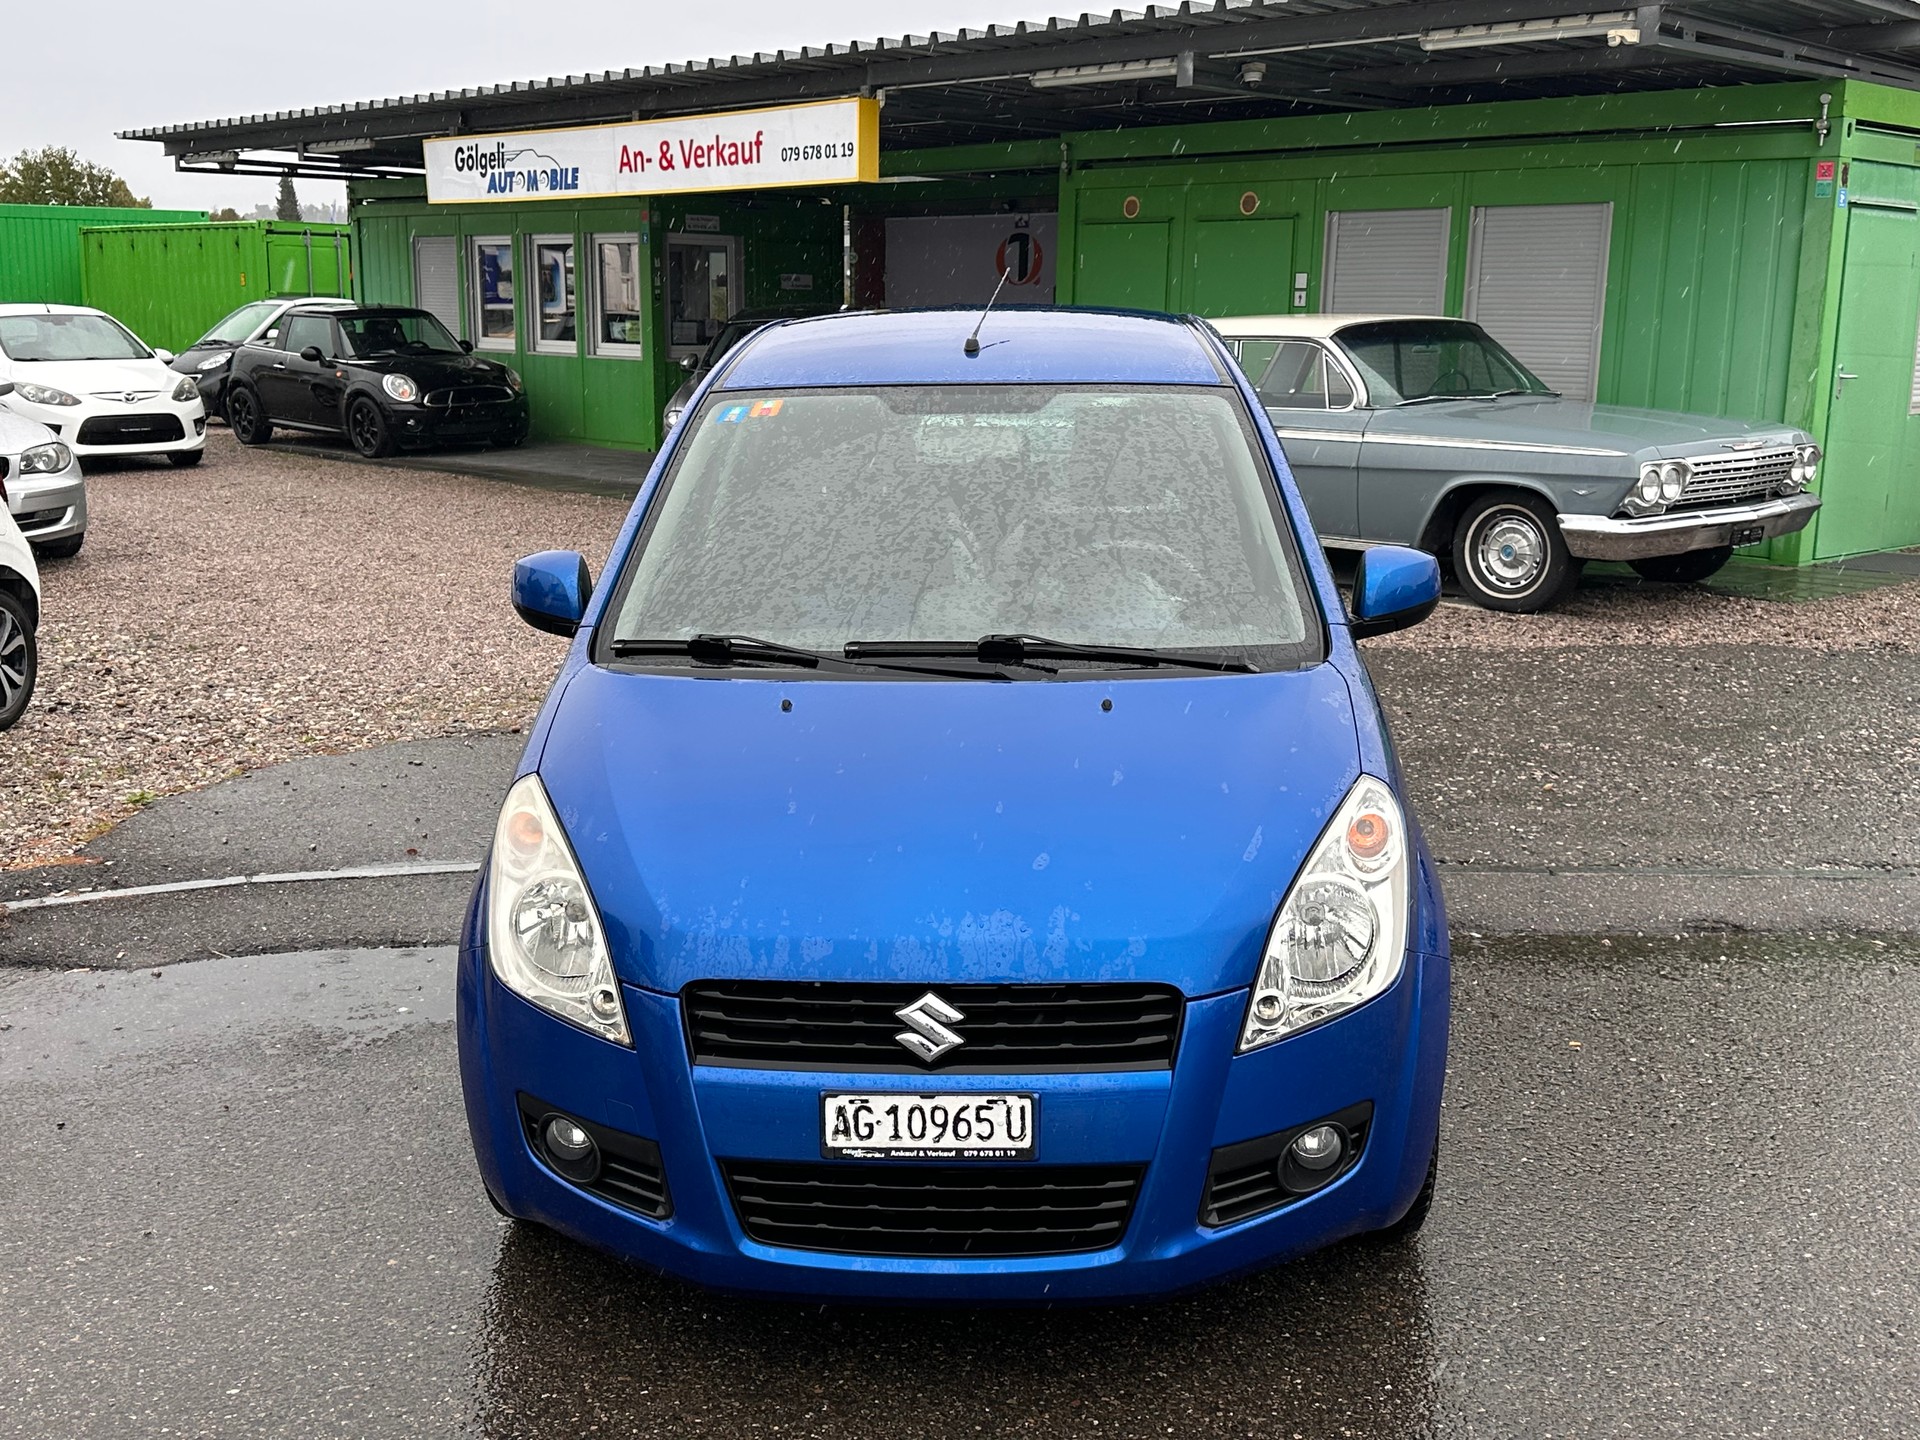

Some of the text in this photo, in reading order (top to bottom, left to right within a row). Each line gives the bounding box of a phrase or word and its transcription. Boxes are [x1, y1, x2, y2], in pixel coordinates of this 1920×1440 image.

[454, 141, 505, 178] Gölgeli
[619, 130, 764, 174] An- & Verkauf
[781, 141, 854, 162] 079 678 01 19
[890, 1149, 918, 1157] Ankauf
[918, 1149, 925, 1157] &
[926, 1149, 956, 1157] Verkauf
[963, 1149, 978, 1157] 079
[979, 1149, 994, 1157] 678
[994, 1149, 1004, 1157] 01
[1006, 1149, 1017, 1157] 19
